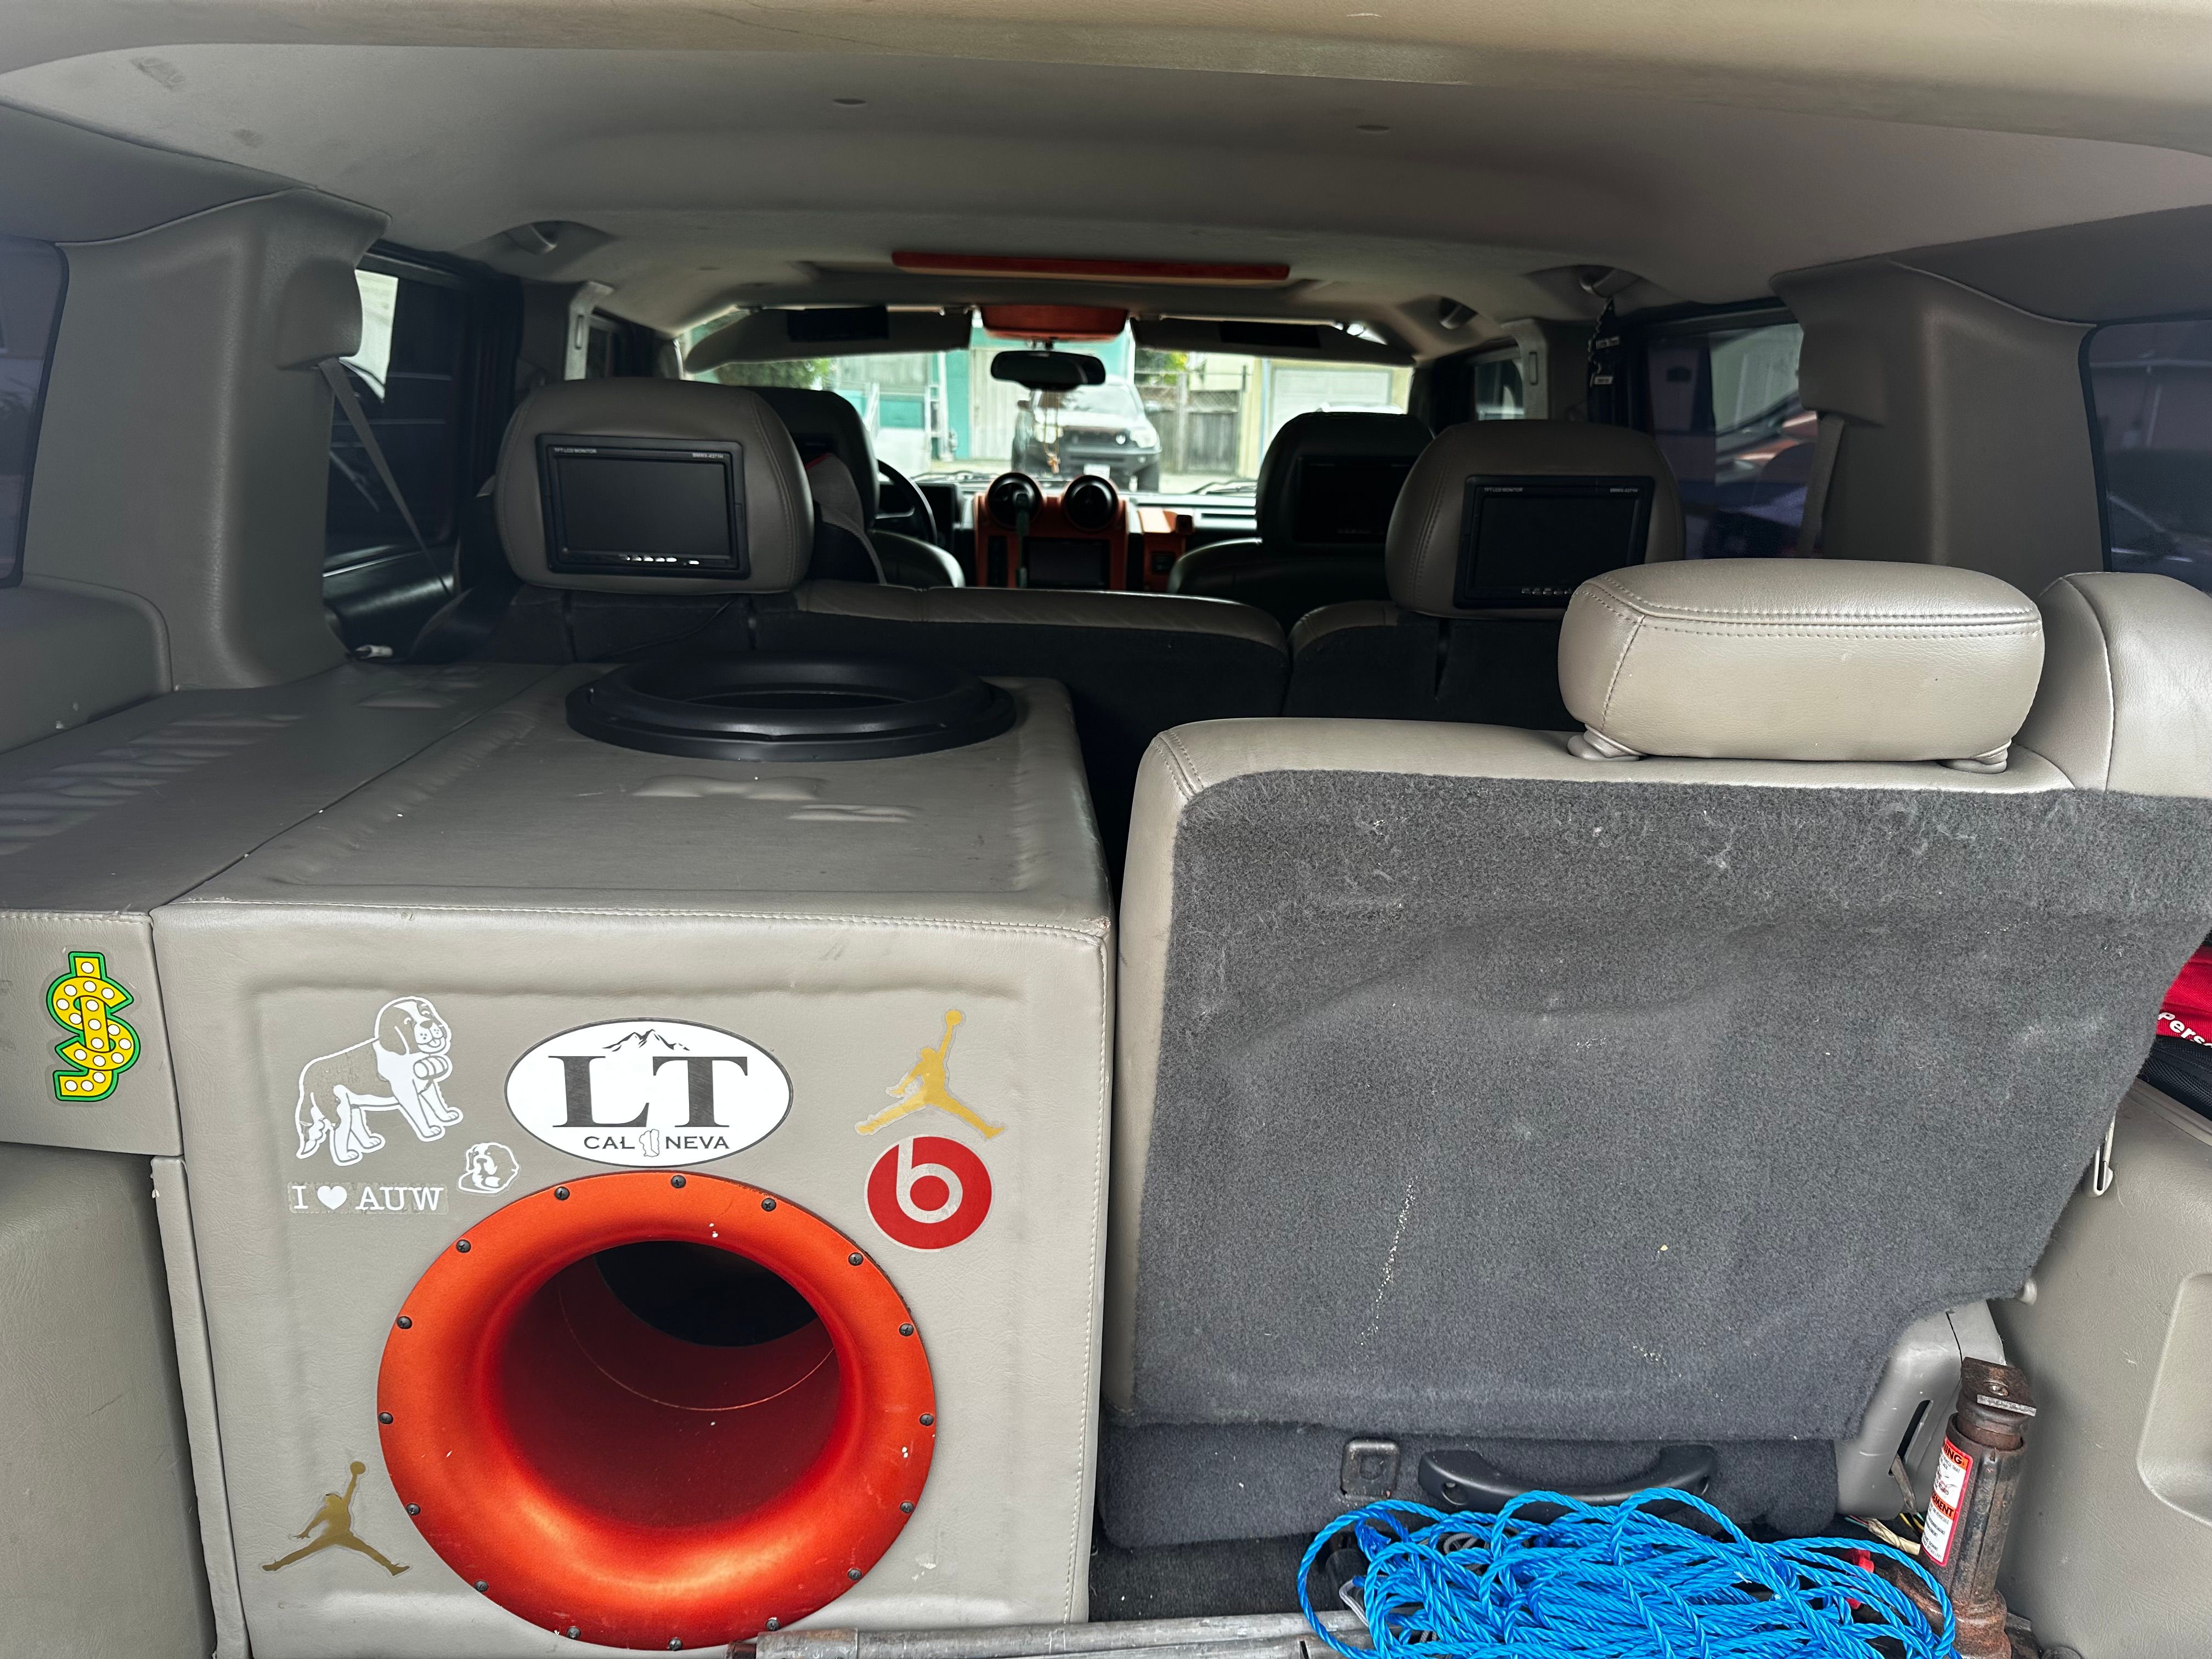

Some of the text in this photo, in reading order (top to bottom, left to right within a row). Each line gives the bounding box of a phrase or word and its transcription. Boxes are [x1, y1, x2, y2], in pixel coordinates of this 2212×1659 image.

[2158, 1012, 2212, 1048] Pers
[548, 1056, 748, 1128] LT
[584, 1135, 730, 1150] CAL NEVA
[292, 1185, 444, 1211] I AUW
